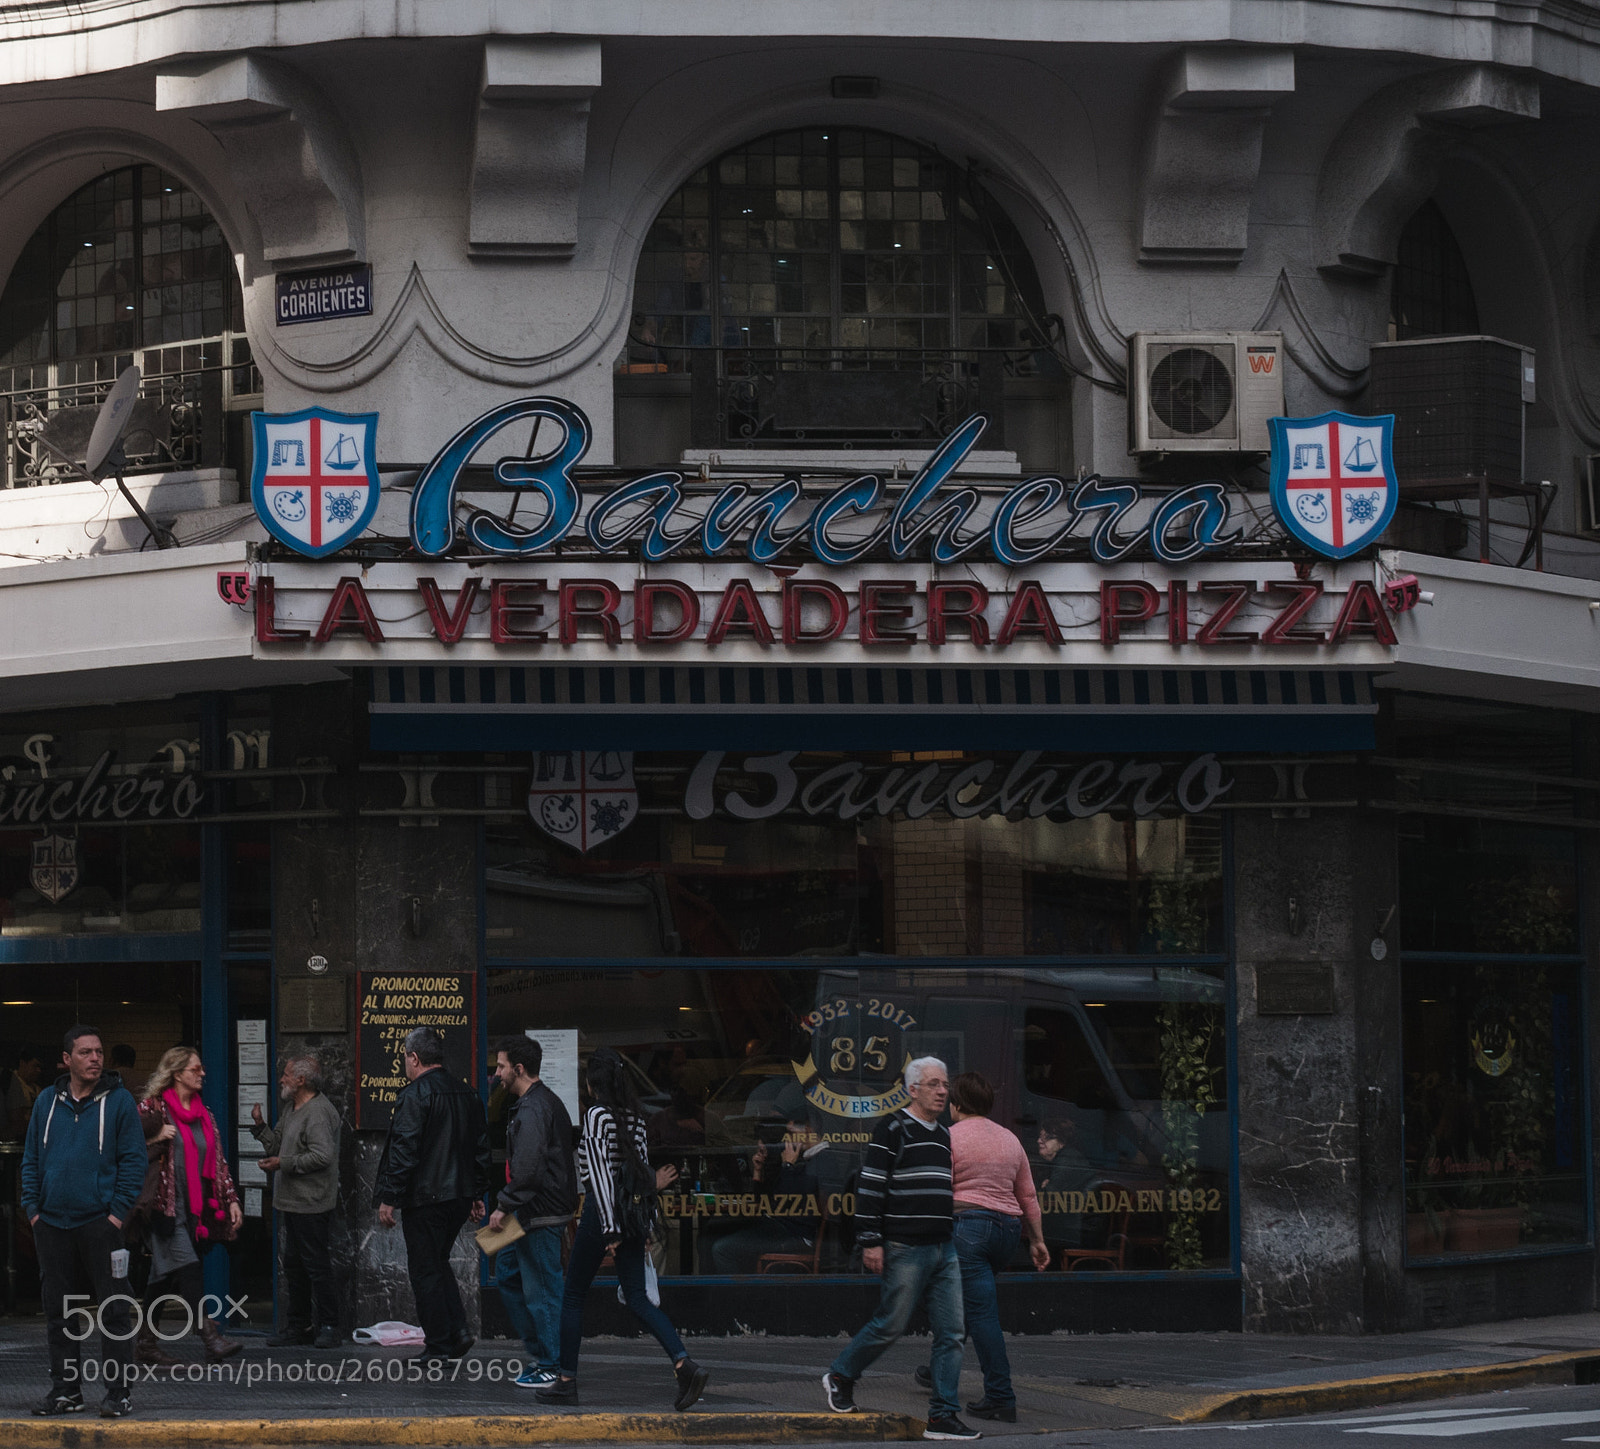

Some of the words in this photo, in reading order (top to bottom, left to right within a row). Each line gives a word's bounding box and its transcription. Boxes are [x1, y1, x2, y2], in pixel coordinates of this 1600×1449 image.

[289, 273, 354, 293] AVENIDA
[280, 285, 366, 318] CORRIENTES
[409, 395, 1245, 567] Banchero
[416, 575, 1067, 647] VERDADERA
[0, 748, 205, 824] nchero
[682, 751, 1236, 821] Banchero
[370, 976, 460, 992] PROMOCIONES
[362, 994, 379, 1009] AL
[383, 995, 465, 1009] MOSTRADOR
[361, 1011, 370, 1025] 2
[369, 1014, 407, 1025] PORCIONES
[407, 1015, 417, 1025] de
[417, 1014, 468, 1026] MUZZARELLA
[800, 999, 850, 1036] 1932
[868, 998, 918, 1032] 2017
[386, 1026, 395, 1039] 2
[830, 1034, 890, 1074] 85
[360, 1073, 369, 1088] 2
[368, 1077, 408, 1088] PORCIONES
[781, 1132, 818, 1143] AIRE
[656, 1193, 677, 1218] E
[679, 1193, 710, 1218] LA
[715, 1192, 822, 1218] FUGAZZA
[1136, 1189, 1164, 1213] EN
[1168, 1187, 1222, 1213] 1932
